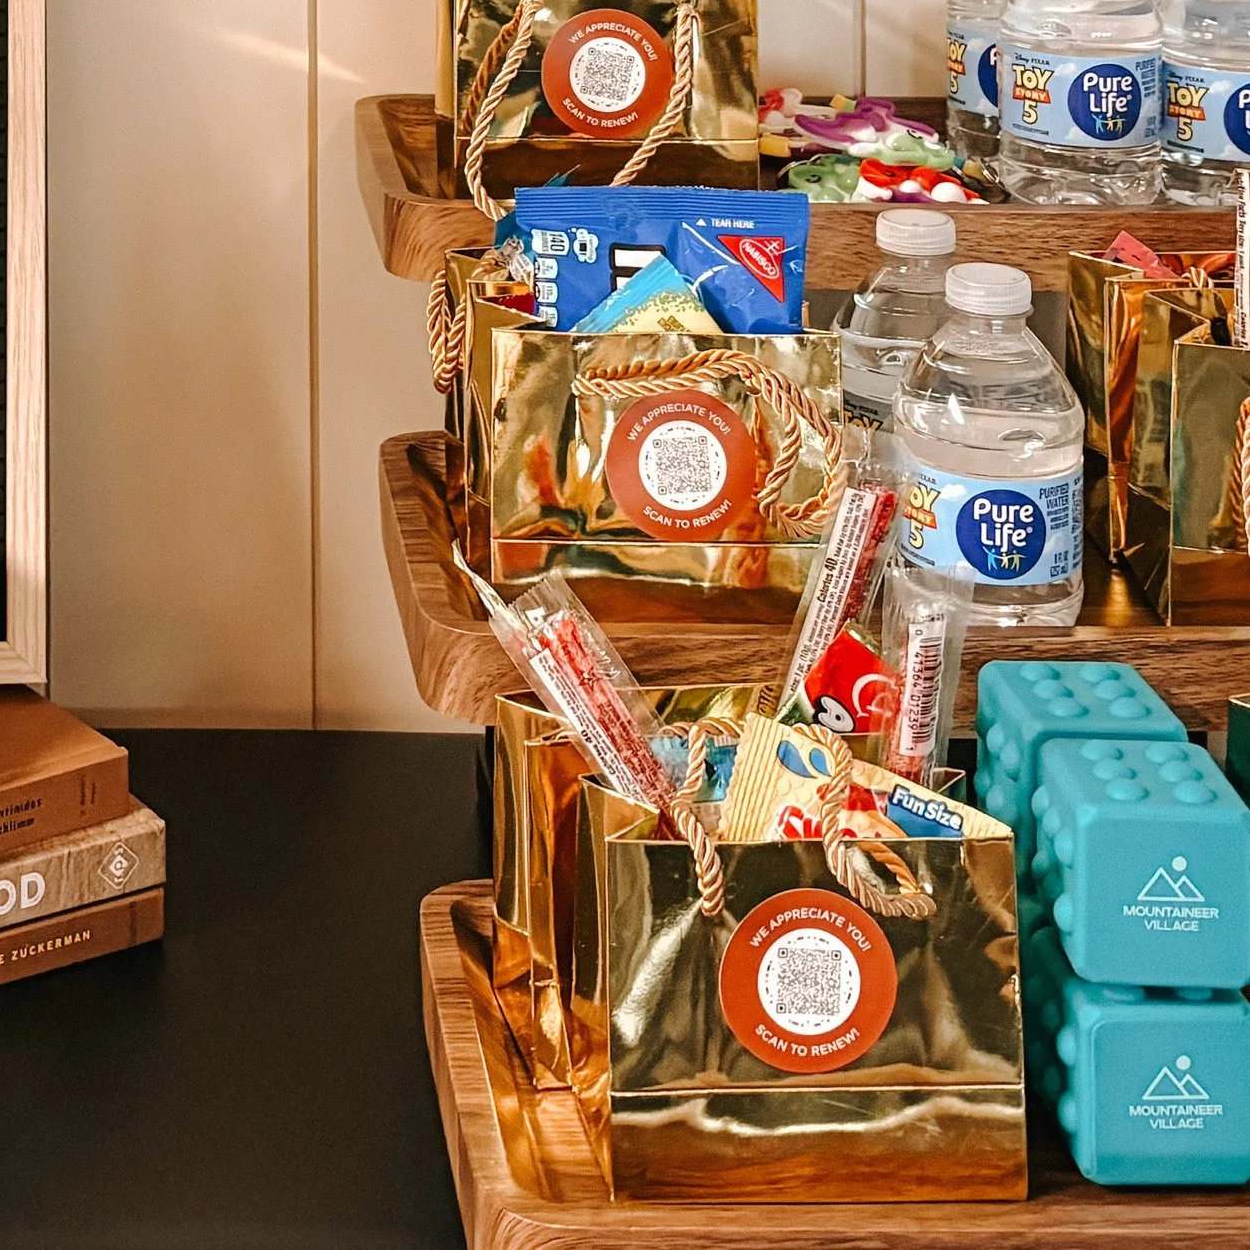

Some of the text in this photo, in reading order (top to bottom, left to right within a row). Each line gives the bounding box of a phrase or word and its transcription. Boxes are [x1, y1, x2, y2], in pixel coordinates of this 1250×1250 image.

[569, 22, 658, 61] WE APPRECIATE YOU!
[949, 37, 967, 62] OY
[1011, 63, 1054, 90] TOY
[1083, 72, 1133, 92] Pure
[1015, 87, 1048, 100] STORY
[1090, 93, 1128, 116] Life
[1166, 80, 1209, 107] TOY
[562, 98, 639, 127] SCAN TO RENEW!
[1022, 99, 1038, 125] 5
[1169, 105, 1202, 118] STORY
[1177, 116, 1193, 141] 5
[733, 220, 754, 229] HERE
[742, 242, 777, 276] NABISCO
[627, 403, 732, 441] WE APPRECIATE YOU!
[910, 481, 941, 512] OY
[1046, 495, 1069, 509] WATER
[643, 499, 732, 529] SCAN TO RENEW!
[973, 498, 1034, 523] Pure
[909, 519, 924, 549] 5
[980, 523, 1027, 552] Life
[815, 572, 834, 603] Calories
[908, 695, 921, 730] 01239
[1123, 905, 1220, 919] MOUNTAINEER
[1144, 919, 1200, 932] VILLAGE
[750, 907, 872, 952] WE APPRECIATE YOU!
[11, 929, 91, 962] ZUCKERMAN
[755, 1024, 861, 1057] SCAN TO RENEW!
[1129, 1103, 1223, 1117] MOUNTAINEER
[1149, 1117, 1204, 1130] VILLAGE
